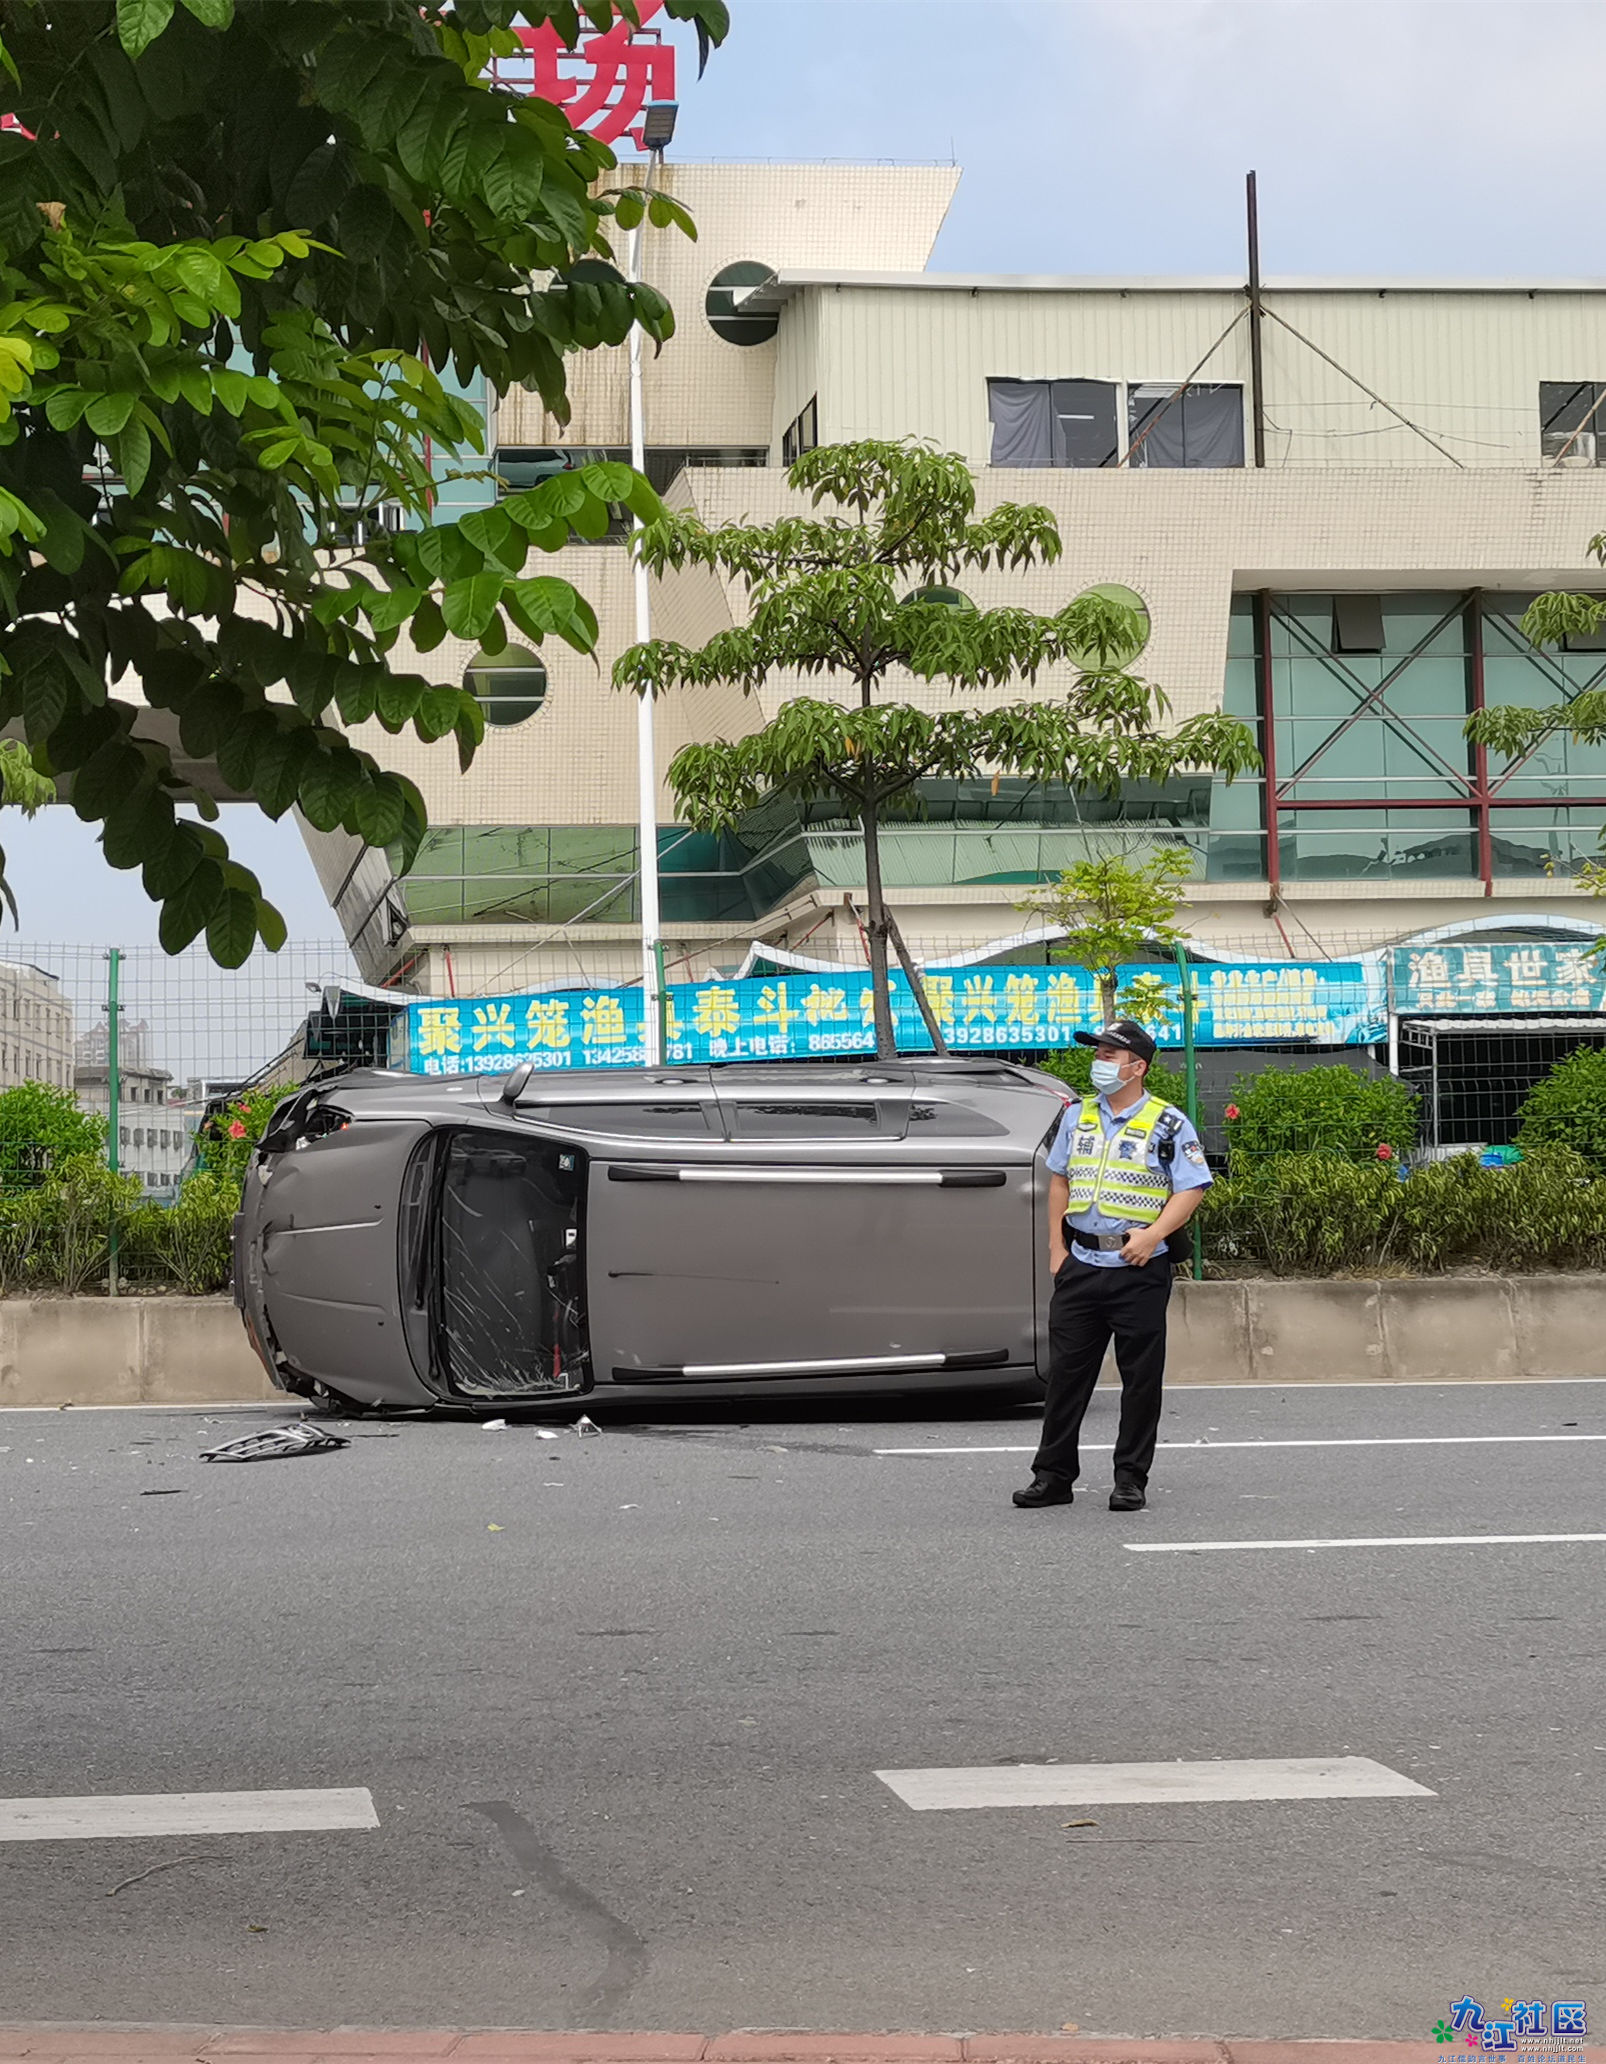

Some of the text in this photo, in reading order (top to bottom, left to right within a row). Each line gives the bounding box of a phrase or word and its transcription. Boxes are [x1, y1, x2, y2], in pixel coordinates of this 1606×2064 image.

[1408, 949, 1599, 988] 渔具世家
[943, 1026, 1071, 1044] 3928635301
